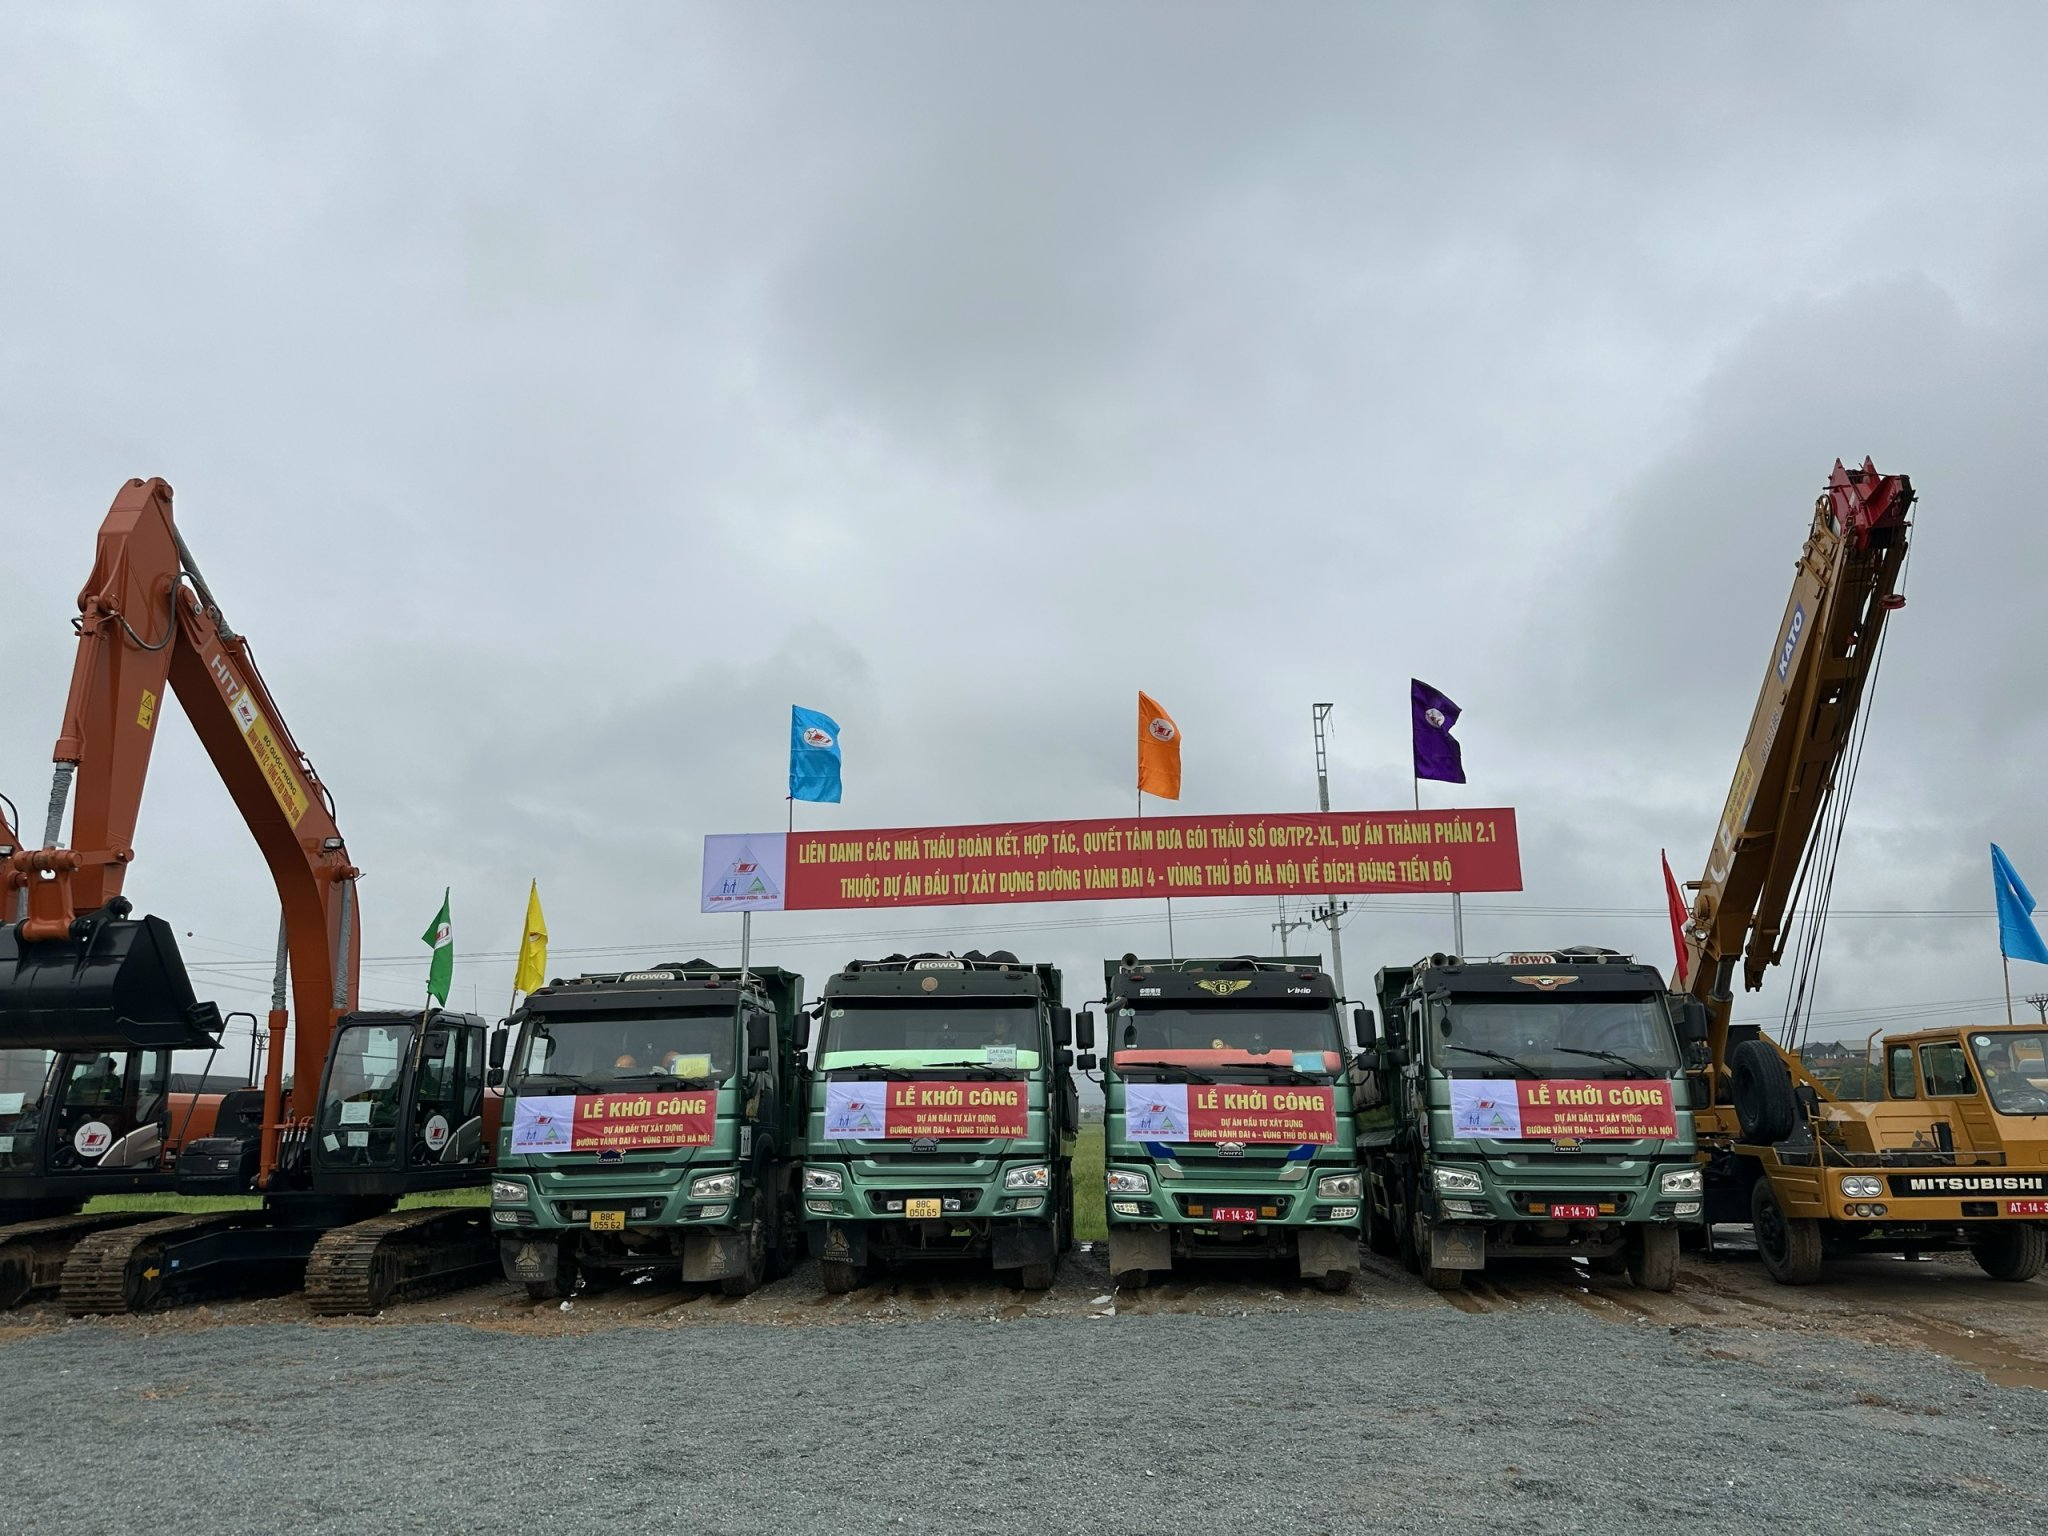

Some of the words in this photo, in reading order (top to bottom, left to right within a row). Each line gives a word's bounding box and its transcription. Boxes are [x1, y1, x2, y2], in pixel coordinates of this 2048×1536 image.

[1779, 611, 1802, 677] KATO
[799, 840, 826, 864] LIÊN
[829, 842, 863, 863] DANH
[866, 837, 891, 861] CÁC
[894, 836, 920, 860] NHÀ
[923, 832, 954, 859] THẦU
[958, 833, 992, 858] ĐOÀN
[995, 829, 1020, 858] KẾT,
[1024, 833, 1049, 859] HỢP
[1052, 829, 1079, 855] TÁC,
[1083, 825, 1122, 854] QUYẾT
[1125, 827, 1153, 851] TÂM
[1156, 828, 1183, 850] ĐƯA
[1186, 825, 1207, 849] GÓI
[1211, 820, 1244, 848] THẦU
[1248, 820, 1266, 848] SỐ
[1269, 825, 1339, 848] 08/TP2-XL,
[1341, 823, 1361, 850] DỰ
[1364, 820, 1383, 844] ÁN
[1386, 819, 1431, 844] THÀNH
[1434, 815, 1473, 844] PHẦN
[1476, 821, 1496, 842] 2.1
[840, 873, 880, 902] THUỘC
[883, 874, 901, 901] DỰ
[904, 872, 921, 896] ÁN
[924, 868, 949, 895] ĐẦU
[953, 871, 969, 895] TƯ
[971, 869, 996, 894] XÂY
[1000, 870, 1034, 897] DỰNG
[1037, 865, 1080, 891] ĐƯỜNG
[1084, 865, 1118, 889] VÀNH
[1122, 867, 1143, 888] ĐAI
[1147, 867, 1155, 887] 4
[1167, 862, 1202, 886] VÙNG
[1205, 858, 1230, 886] THỦ
[1233, 860, 1251, 885] ĐÔ
[1255, 860, 1273, 884] HÀ
[1276, 859, 1300, 889] NỘI
[1303, 856, 1320, 884] VỀ
[1323, 859, 1355, 883] ĐÍCH
[1358, 857, 1396, 882] ĐÚNG
[1398, 854, 1430, 882] TIẾN
[1432, 856, 1453, 886] ĐỘ
[1510, 955, 1552, 964] HOWO
[895, 1085, 916, 1106] LỄ
[921, 1085, 963, 1106] KHỞI
[969, 1087, 1018, 1106] CÔNG
[1197, 1088, 1218, 1109] LỄ
[1224, 1089, 1267, 1110] KHỞI
[1273, 1092, 1325, 1112] CÔNG
[1528, 1084, 1550, 1106] LỄ
[1557, 1085, 1603, 1106] KHỞI
[1608, 1086, 1663, 1106] CÔNG
[583, 1098, 604, 1119] LỄ
[609, 1097, 651, 1118] KHỞI
[657, 1097, 707, 1115] CÔNG
[945, 1126, 950, 1134] 4
[1251, 1130, 1257, 1139] 4
[1588, 1126, 1594, 1135] 4
[631, 1137, 637, 1145] 4
[1910, 1178, 2043, 1190] MITSUBISHI
[916, 1200, 931, 1208] 88C
[600, 1213, 615, 1221] 88C
[909, 1209, 937, 1217] 050.65
